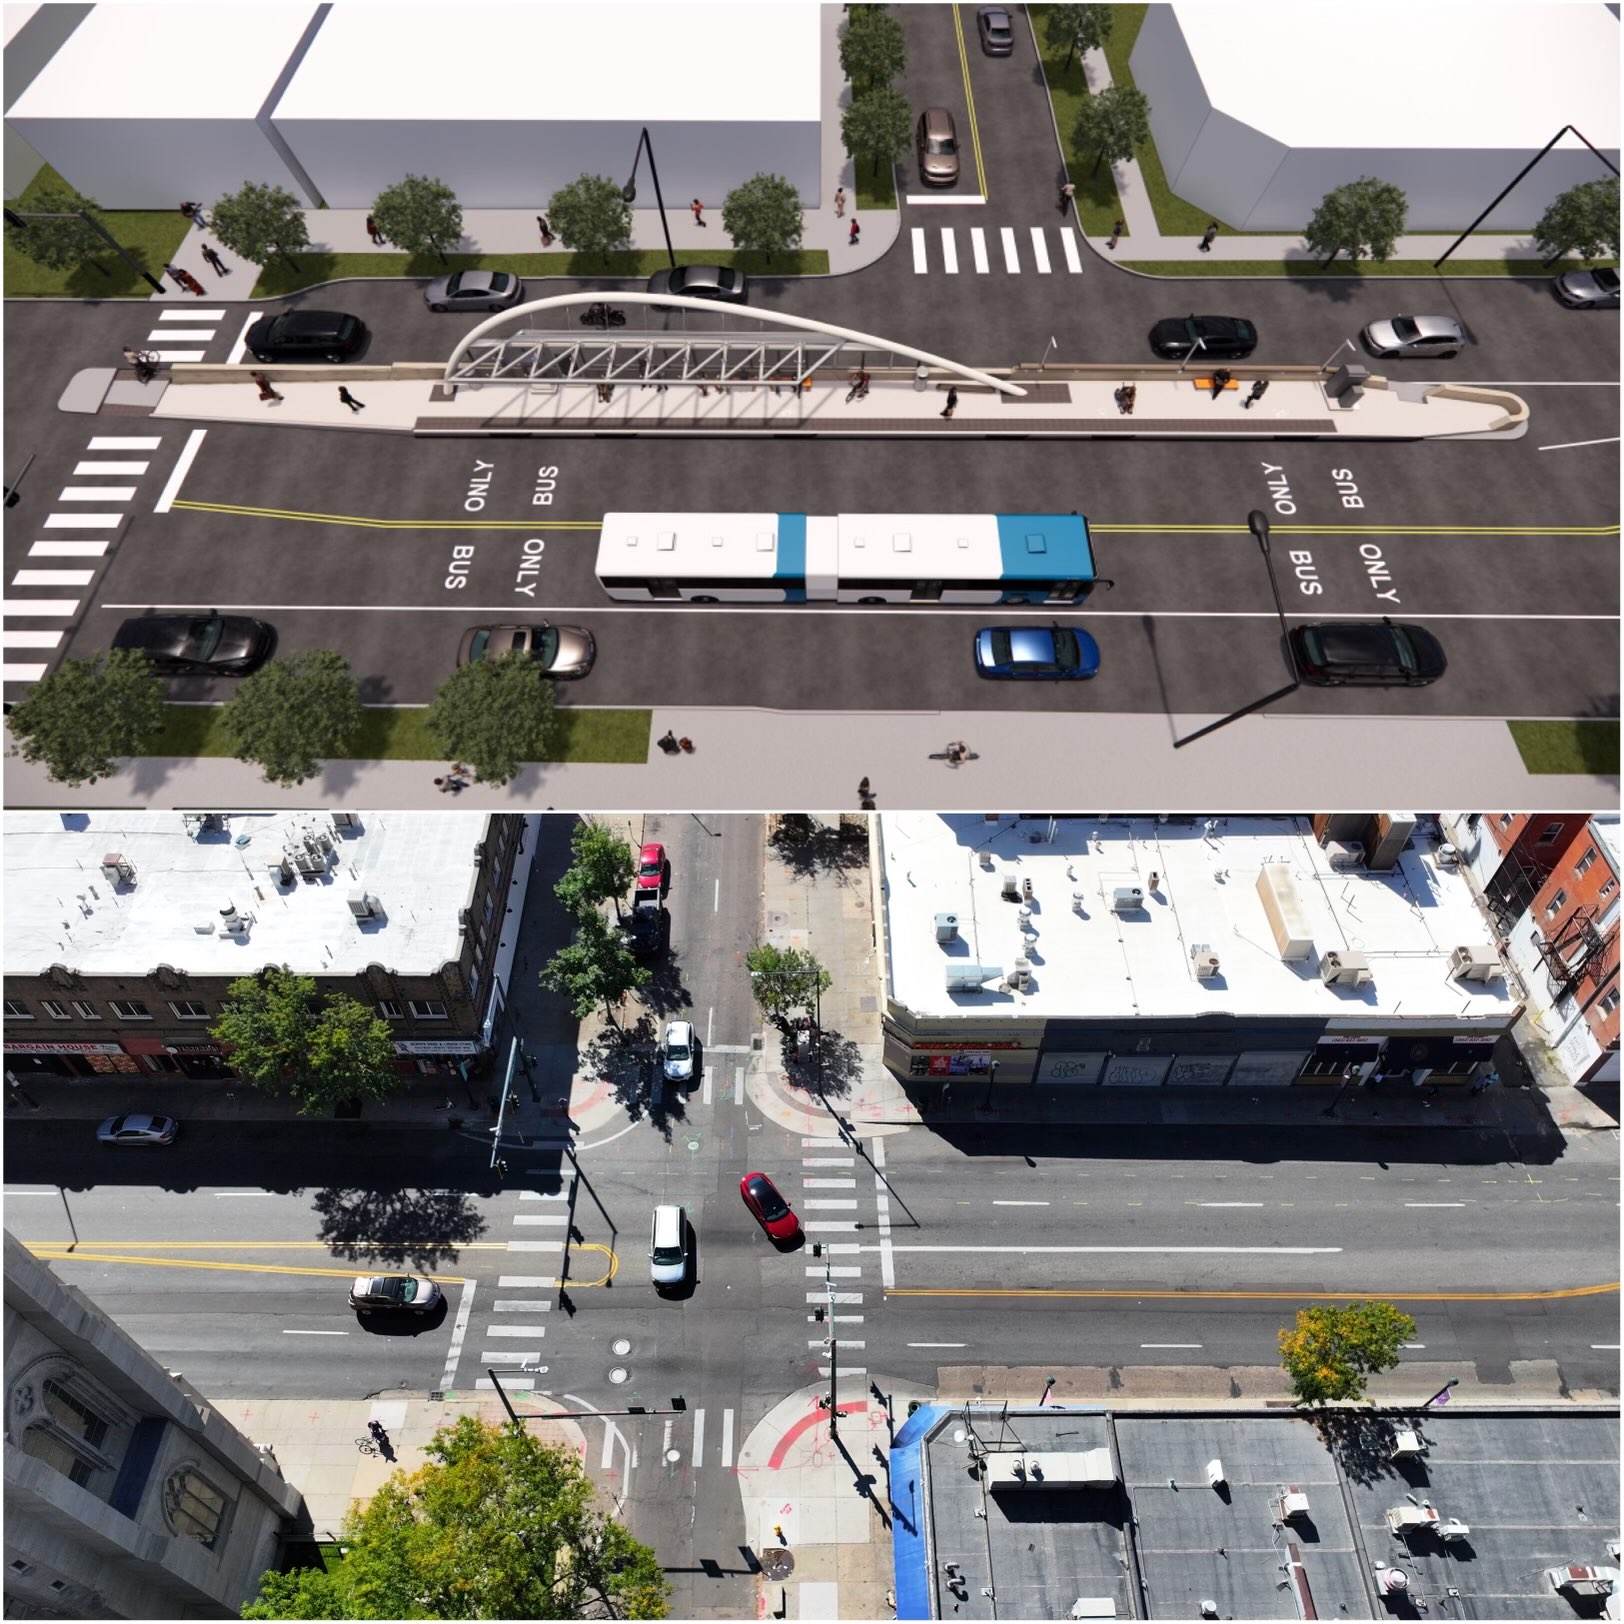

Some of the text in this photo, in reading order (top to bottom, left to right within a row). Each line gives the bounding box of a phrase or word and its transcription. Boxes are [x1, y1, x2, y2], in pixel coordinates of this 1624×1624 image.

[464, 459, 494, 512] ONLY
[533, 466, 559, 505] BUS
[1261, 462, 1297, 515] ONLY
[1331, 468, 1365, 509] BUS
[445, 545, 475, 590] BUS
[514, 538, 545, 598] ONLY
[1289, 550, 1323, 595] BUS
[1359, 543, 1401, 604] ONLY
